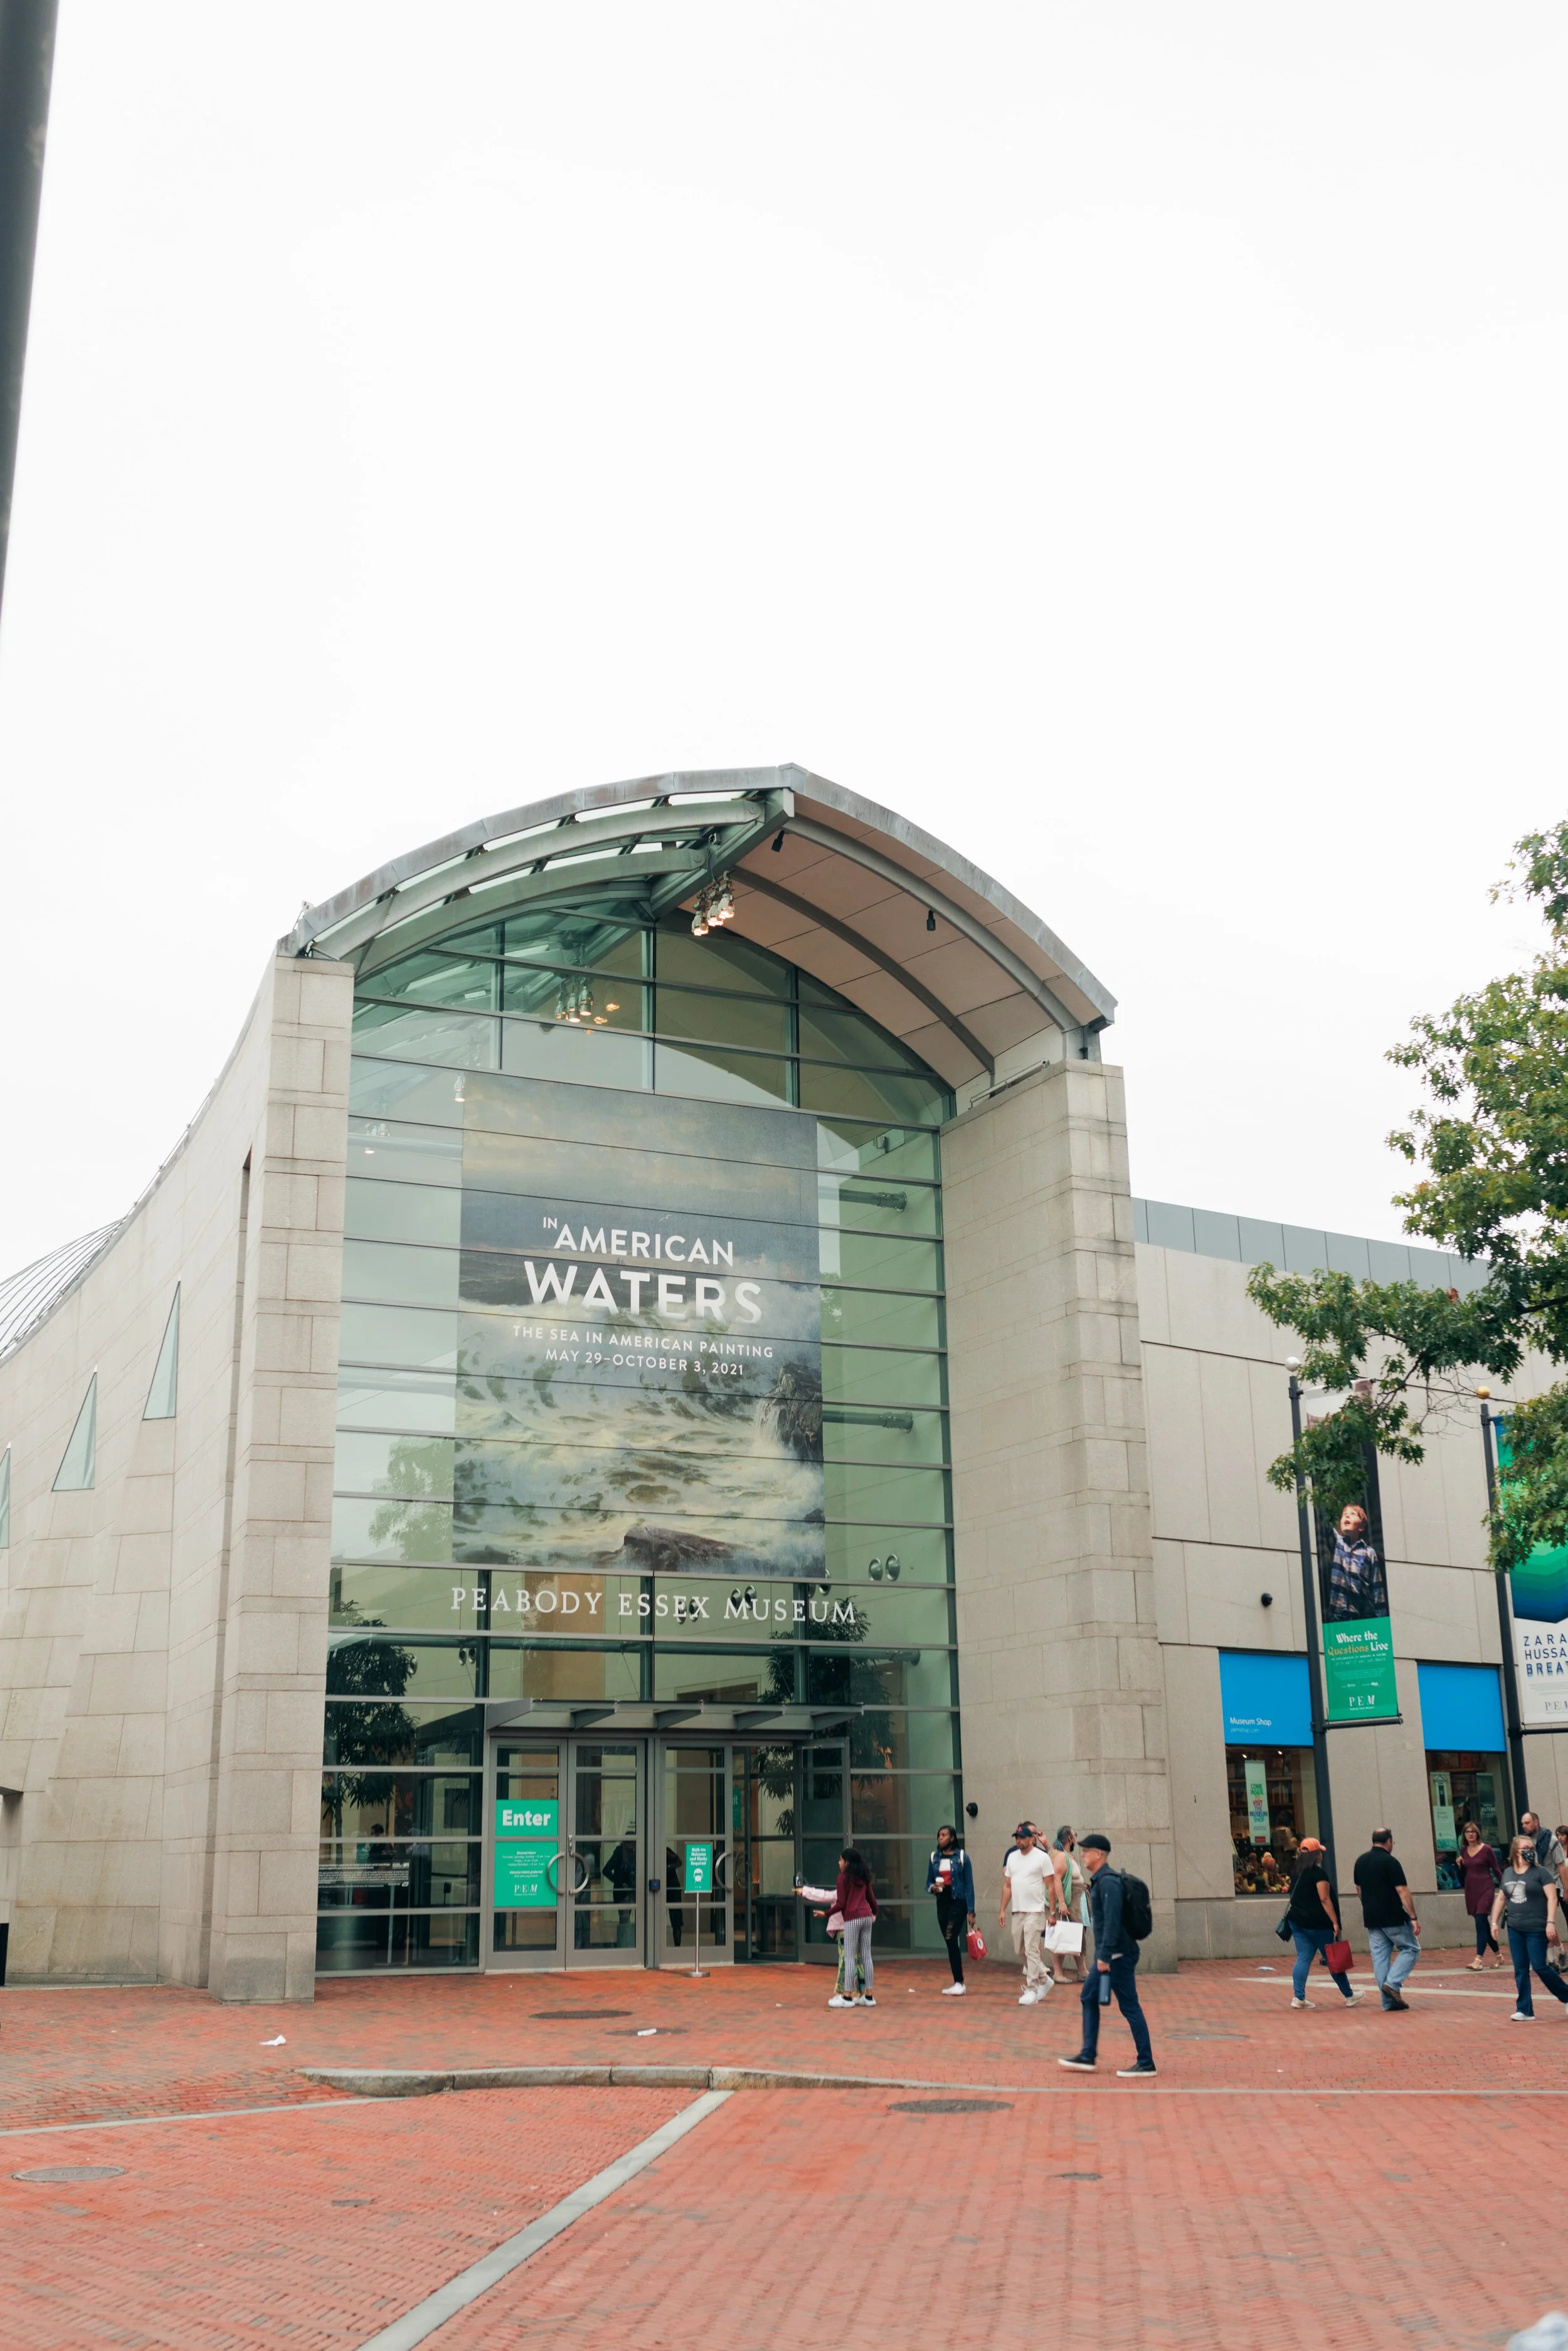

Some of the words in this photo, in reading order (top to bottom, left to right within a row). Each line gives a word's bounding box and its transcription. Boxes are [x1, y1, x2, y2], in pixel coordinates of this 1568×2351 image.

[543, 1217, 557, 1229] IN
[554, 1224, 733, 1266] AMERICAN
[524, 1261, 762, 1324] WATERS
[513, 1325, 543, 1339] THE
[550, 1329, 579, 1342] SEA
[586, 1332, 602, 1344] IN
[609, 1334, 692, 1351] AMERICAN
[700, 1341, 773, 1358] PAINTING
[546, 1349, 580, 1362] MAY
[694, 1361, 706, 1375] 3,
[712, 1362, 743, 1375] 2021
[450, 1588, 602, 1615] PEABODY
[618, 1594, 709, 1618] ESSEX
[724, 1598, 857, 1623] MUSEUM
[1336, 1633, 1362, 1643] Where
[1364, 1630, 1378, 1641] the
[1523, 1633, 1567, 1647] ZARA
[1328, 1645, 1369, 1656] Questions
[1370, 1642, 1389, 1652] Live
[1525, 1647, 1567, 1660] HUSSA
[1230, 1717, 1255, 1725] Museum
[1256, 1717, 1272, 1726] Shop
[502, 1809, 551, 1827] Enter
